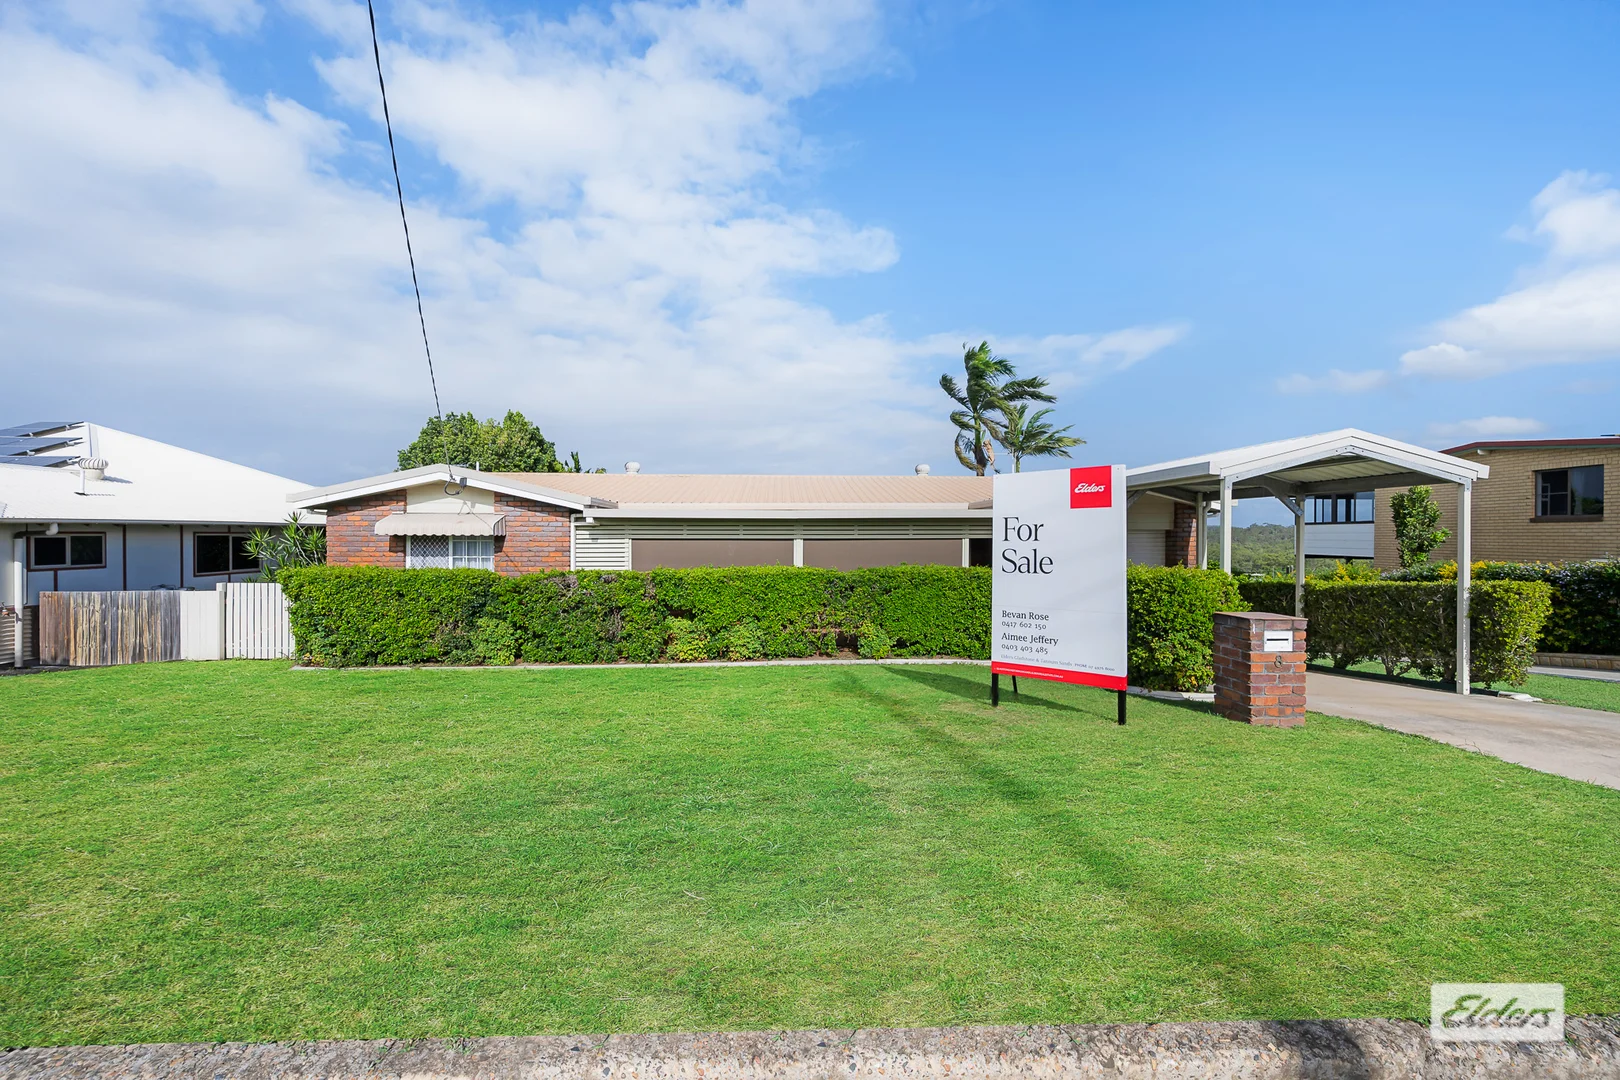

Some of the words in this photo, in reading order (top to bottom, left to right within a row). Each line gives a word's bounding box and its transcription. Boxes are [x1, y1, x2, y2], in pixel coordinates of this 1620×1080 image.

[1074, 482, 1105, 494] Elders
[1002, 516, 1044, 542] For
[1001, 548, 1054, 574] Sale
[1001, 610, 1027, 620] Bevan
[1028, 612, 1049, 621] Rose
[1019, 621, 1032, 629] 602
[1035, 623, 1047, 631] 150
[1001, 632, 1028, 642] Aimee
[1029, 634, 1059, 647] Jeffery
[1001, 643, 1018, 652] 0403
[1020, 645, 1033, 653] 403
[1035, 646, 1049, 655] 485
[1273, 655, 1282, 669] 8
